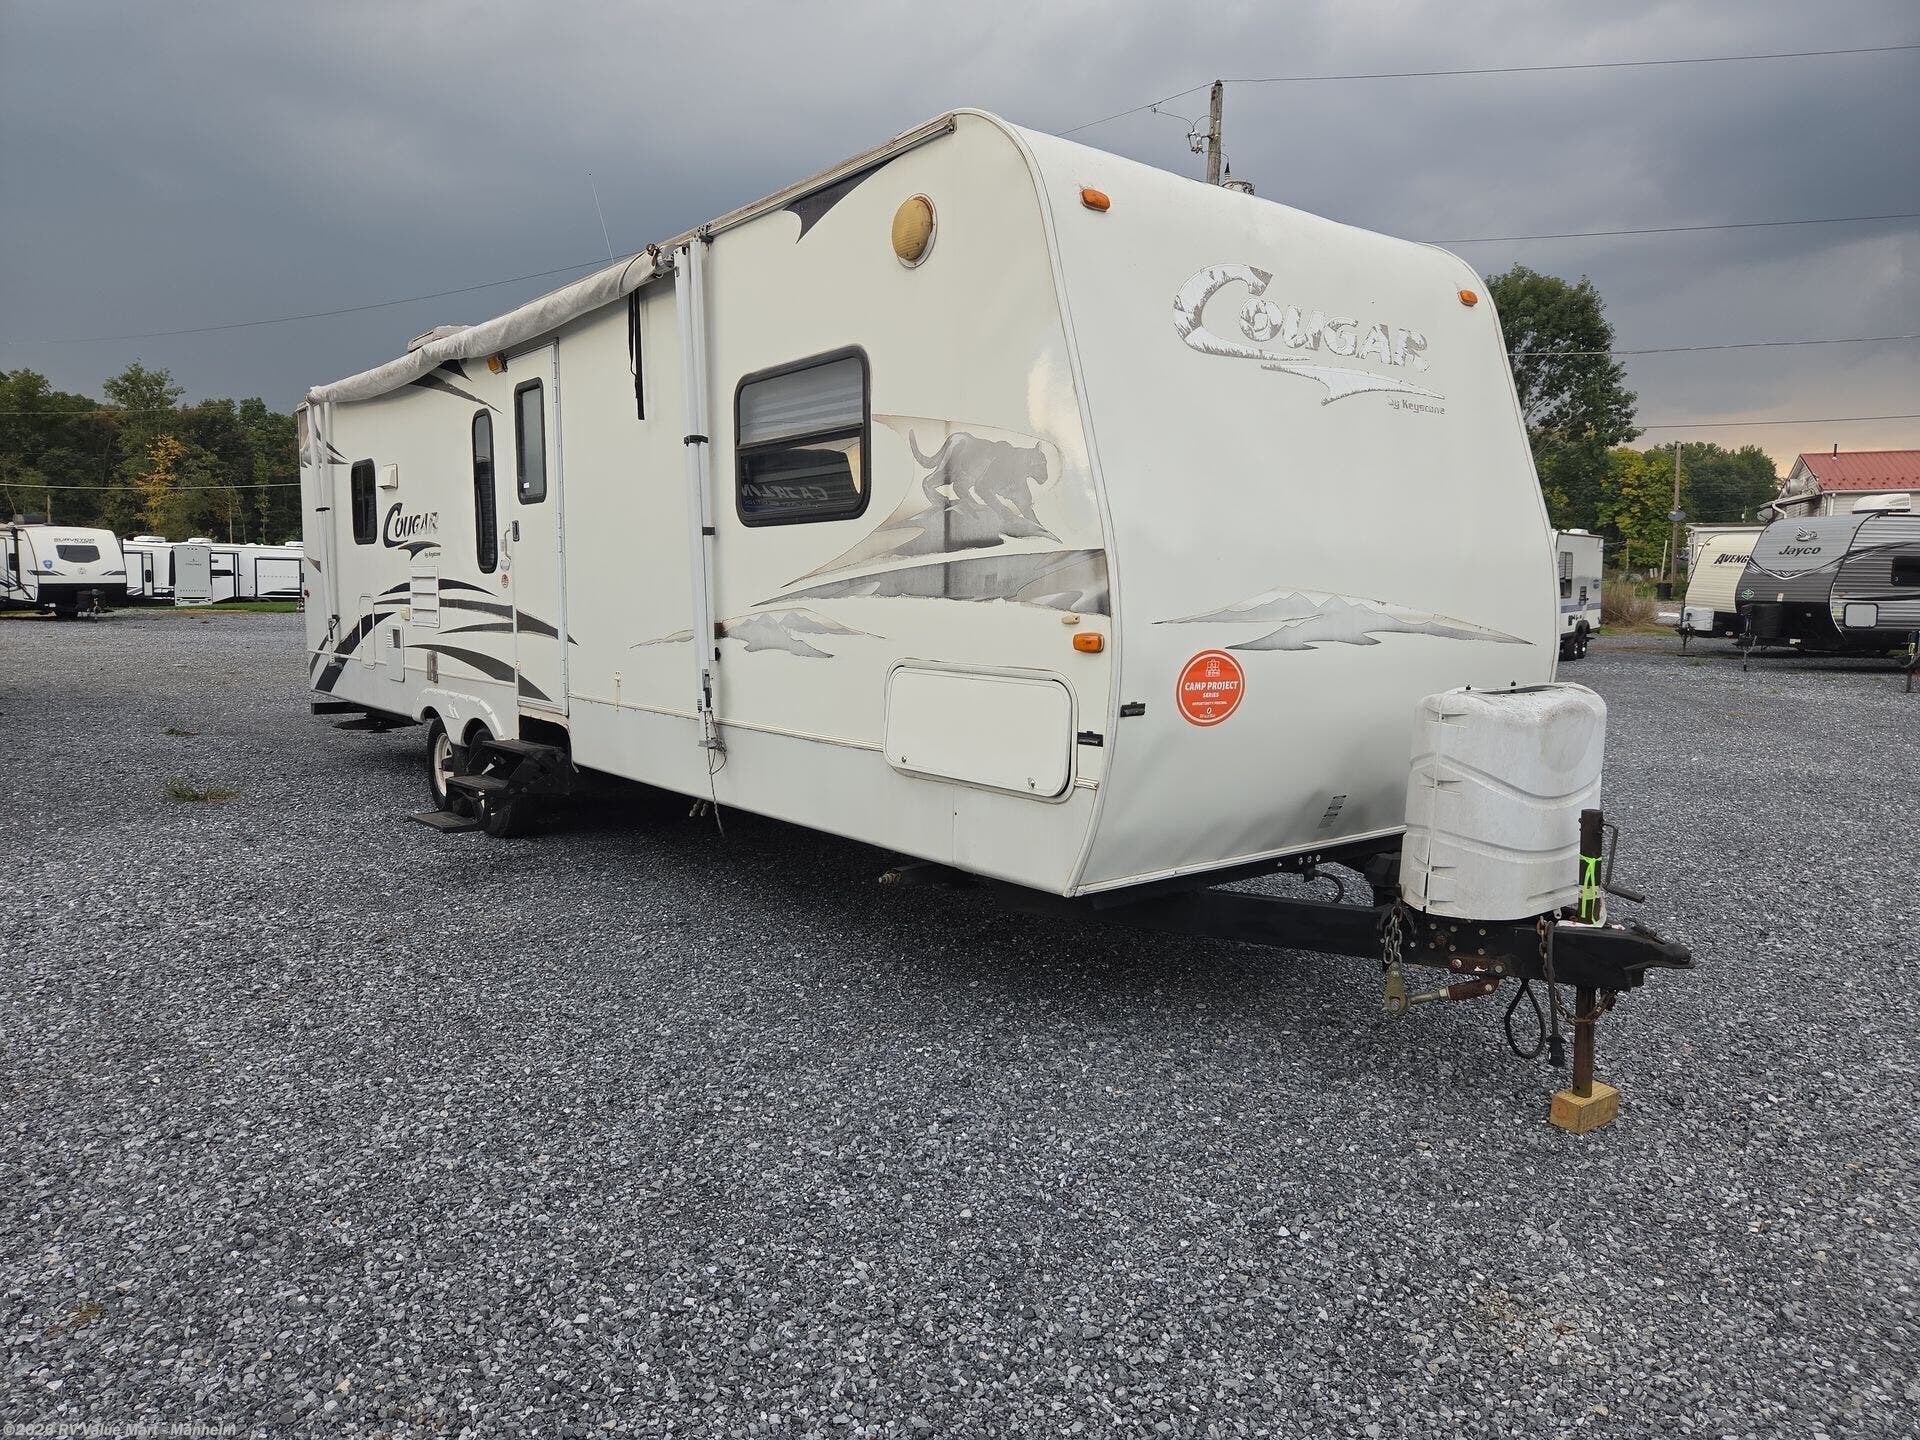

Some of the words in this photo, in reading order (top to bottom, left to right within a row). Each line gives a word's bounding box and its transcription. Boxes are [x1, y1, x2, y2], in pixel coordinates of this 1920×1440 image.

[1173, 263, 1430, 373] COUGAR
[383, 502, 439, 548] COUGAR
[1778, 545, 1822, 557] Jayco
[1184, 681, 1207, 691] CAMP
[1207, 680, 1239, 691] PROJECT
